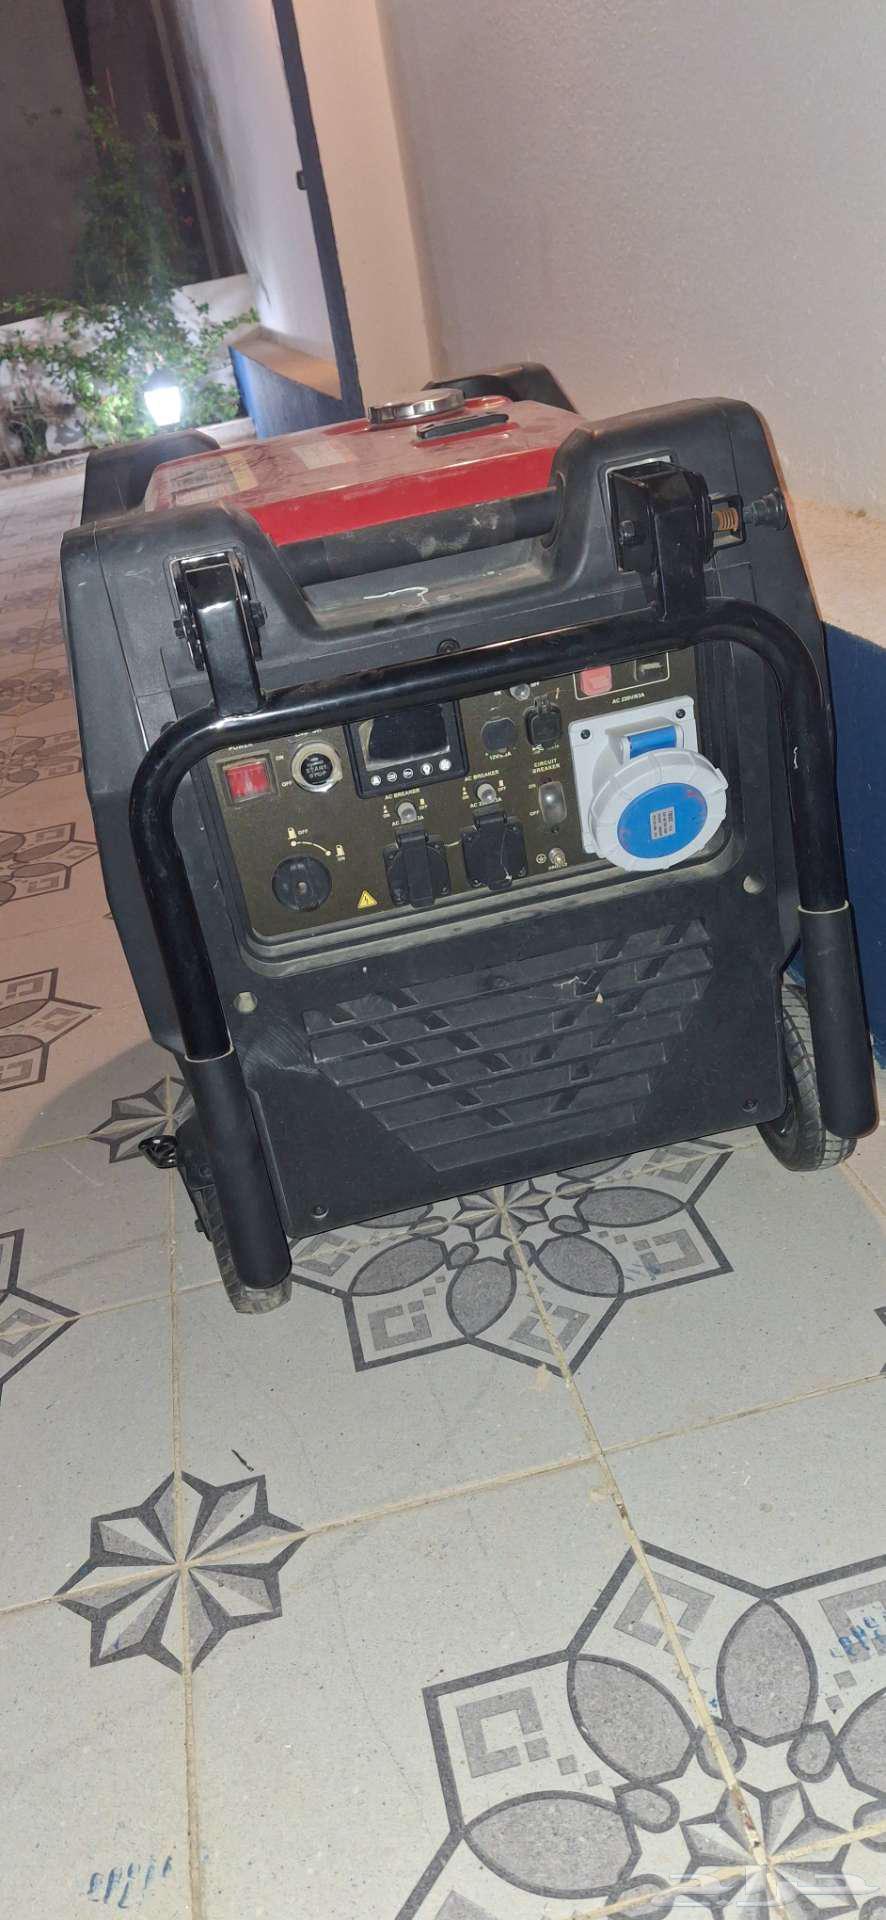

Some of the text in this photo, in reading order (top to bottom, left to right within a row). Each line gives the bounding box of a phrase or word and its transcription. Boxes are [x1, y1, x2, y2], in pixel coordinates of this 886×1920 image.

[305, 763, 327, 774] START
[532, 763, 561, 774] BREAKER
[533, 758, 558, 768] CIRCUIT
[473, 769, 500, 780] BREAKER
[393, 787, 420, 799] BREAKER
